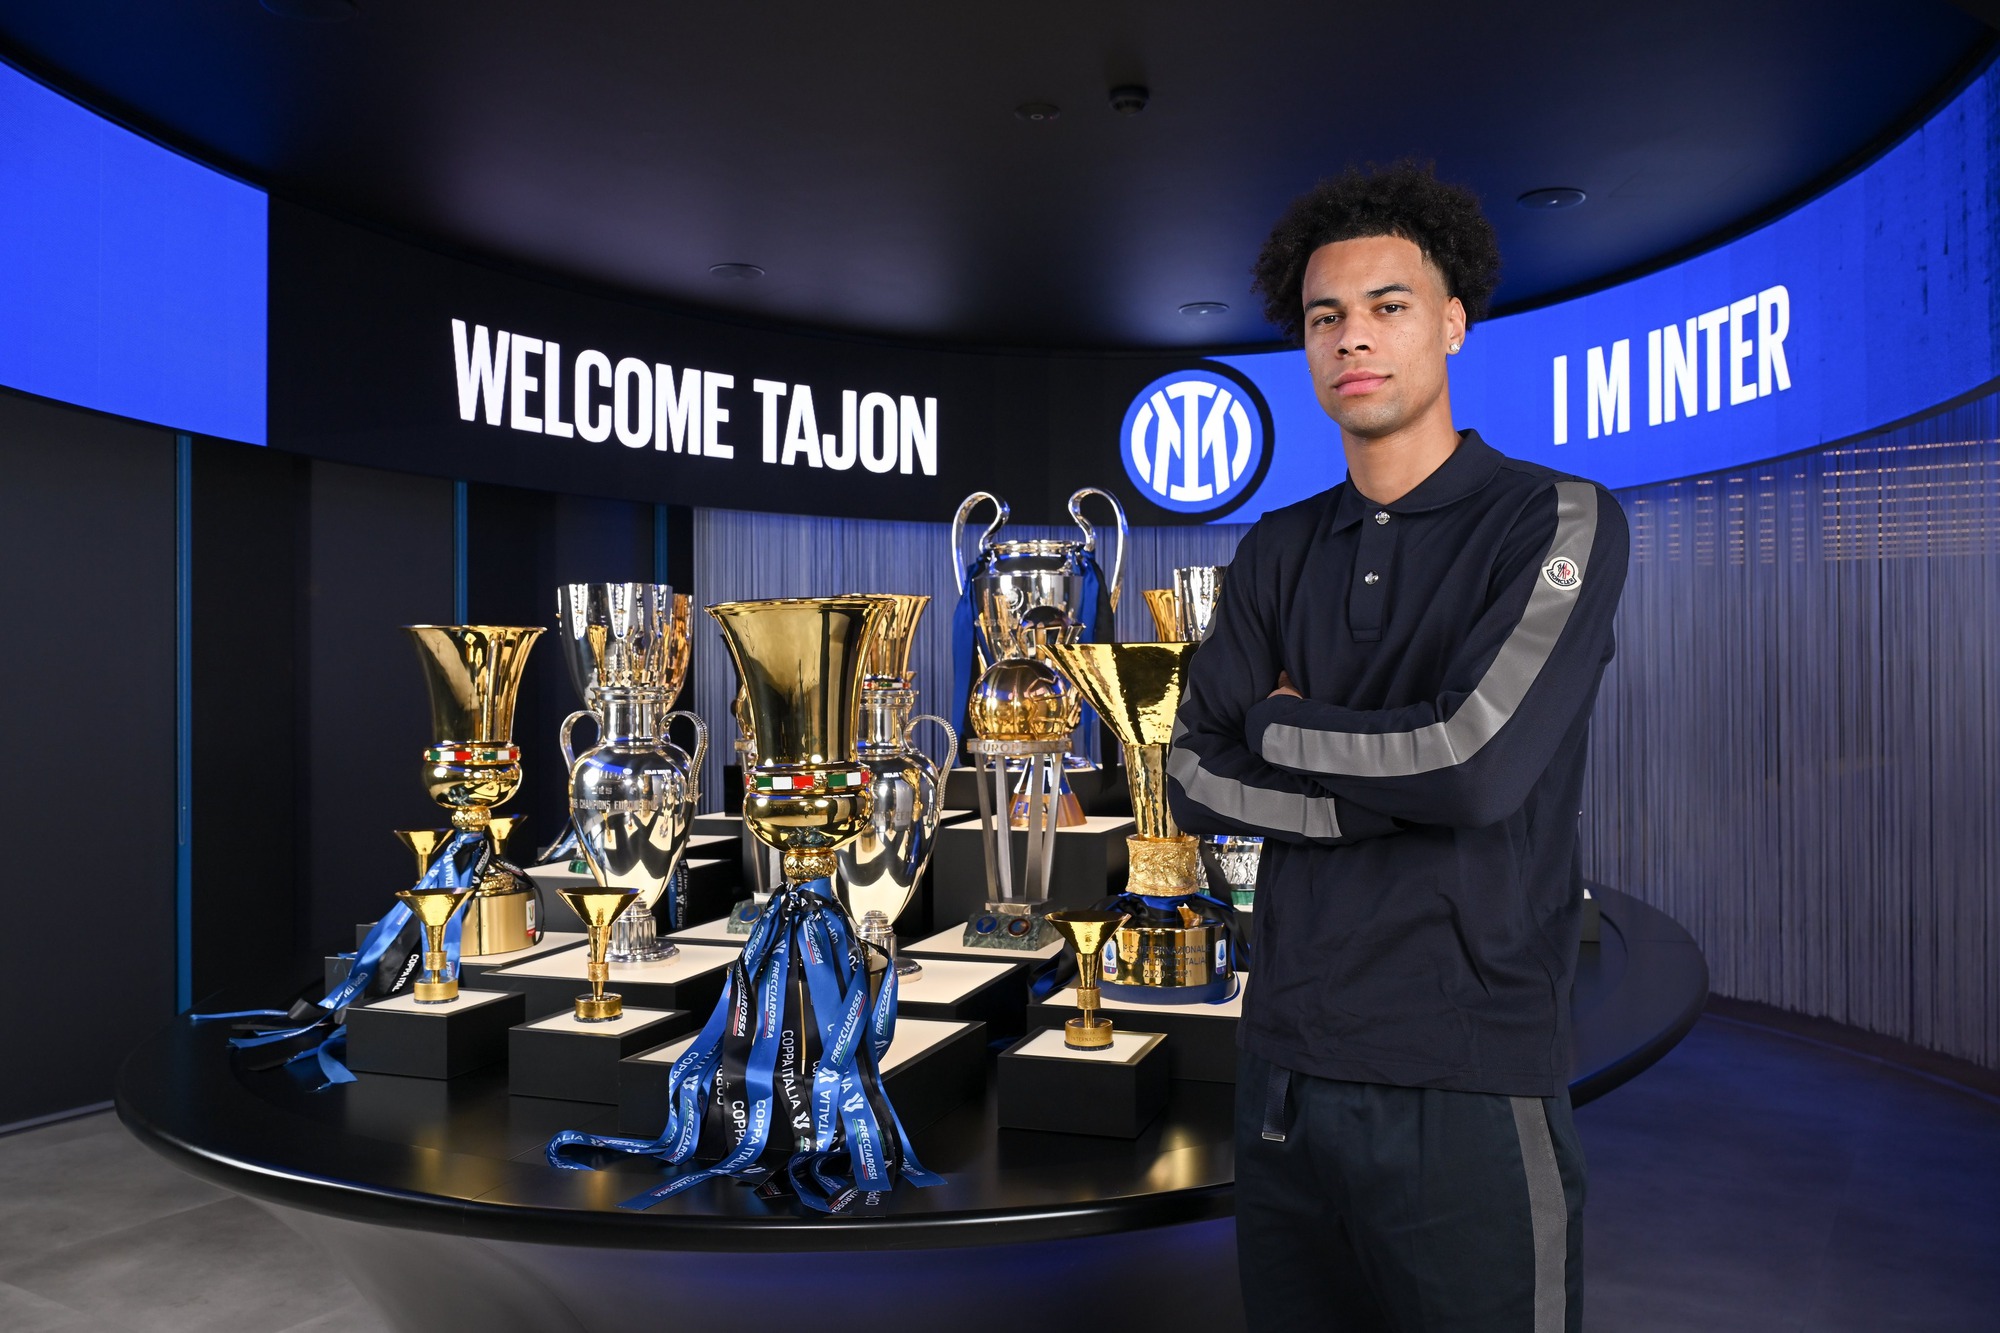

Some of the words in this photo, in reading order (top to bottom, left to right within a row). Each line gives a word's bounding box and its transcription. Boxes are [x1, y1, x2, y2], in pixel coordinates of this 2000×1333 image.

[1553, 355, 1568, 446] I
[1587, 338, 1631, 440] M
[1648, 284, 1792, 427] INTER
[452, 318, 734, 460] WELCOME
[753, 378, 937, 476] TAJON
[1549, 570, 1574, 585] MONCLER
[391, 976, 407, 992] ITAL
[401, 953, 420, 978] COPPA
[767, 960, 780, 1039] FRECCIAROSSA
[781, 1029, 795, 1067] COPPA
[830, 989, 864, 1064] FRECCIAROSSA
[782, 1067, 802, 1110] ITALIA
[748, 1099, 767, 1146] COPPA
[818, 1089, 832, 1135] ITALIA
[722, 1147, 756, 1169] ITALIA
